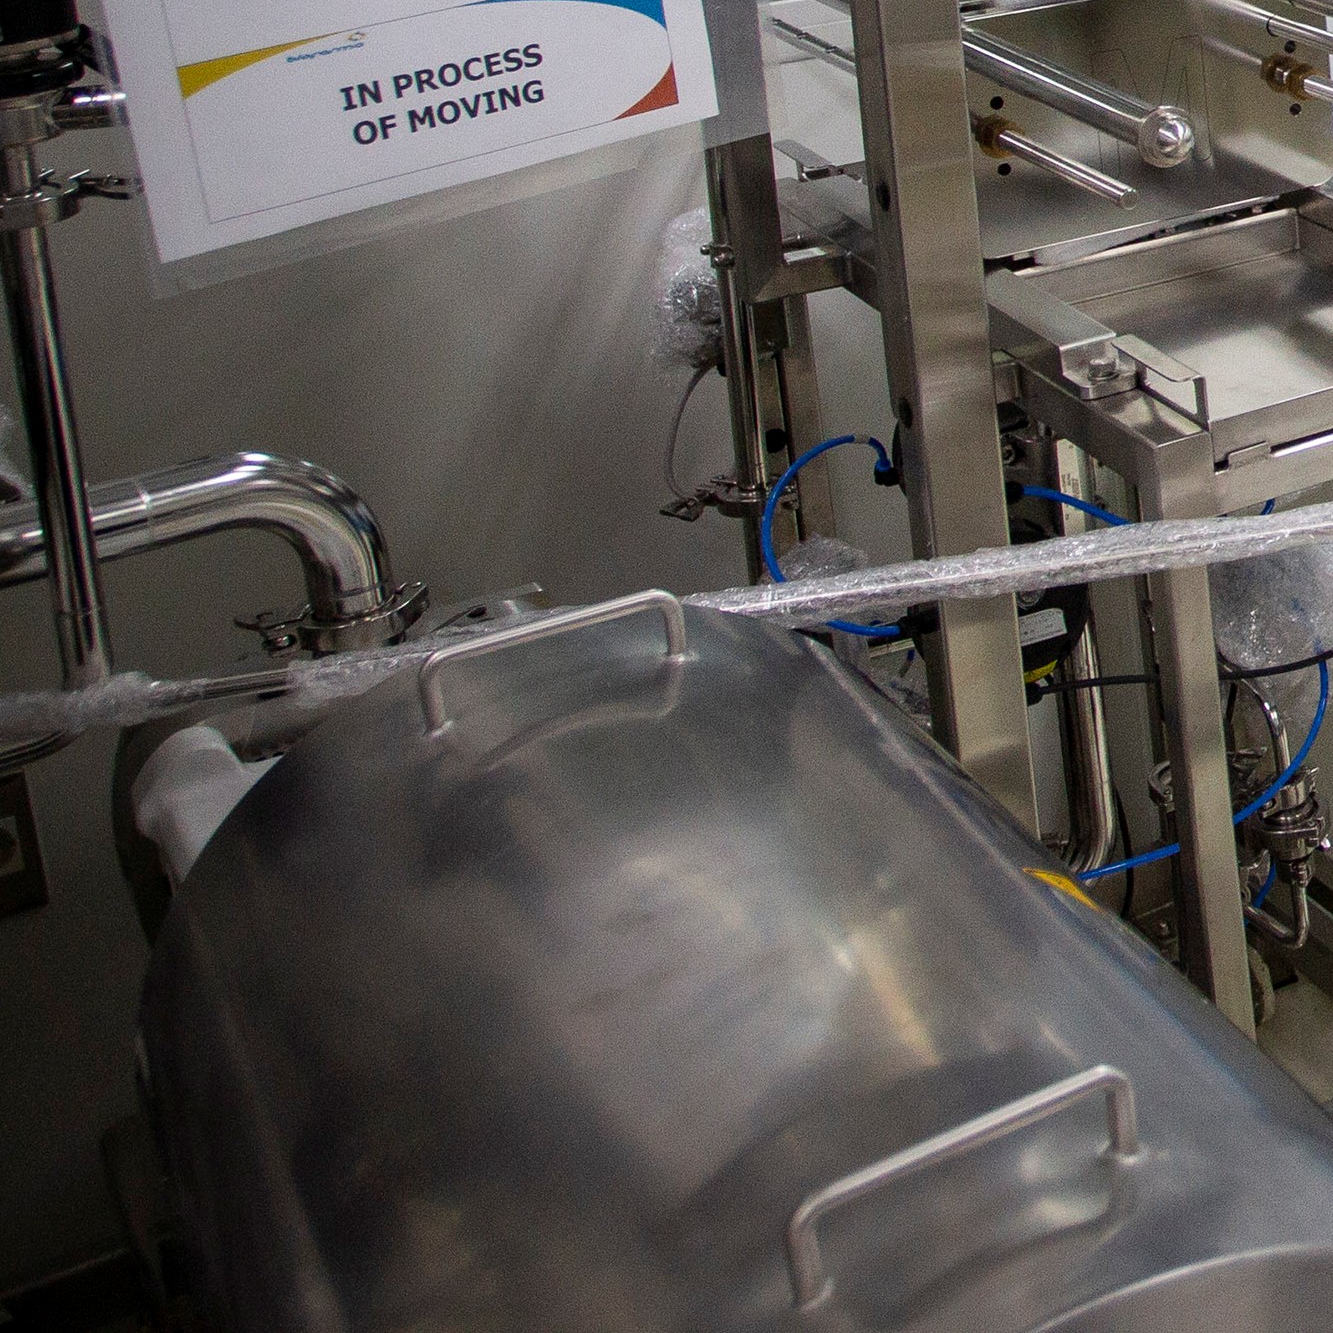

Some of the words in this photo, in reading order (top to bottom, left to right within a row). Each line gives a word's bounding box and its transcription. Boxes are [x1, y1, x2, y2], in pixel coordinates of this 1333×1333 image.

[340, 80, 383, 112] IN
[393, 43, 544, 99] PROCESS
[353, 114, 397, 145] OF
[407, 79, 545, 133] MOVING
